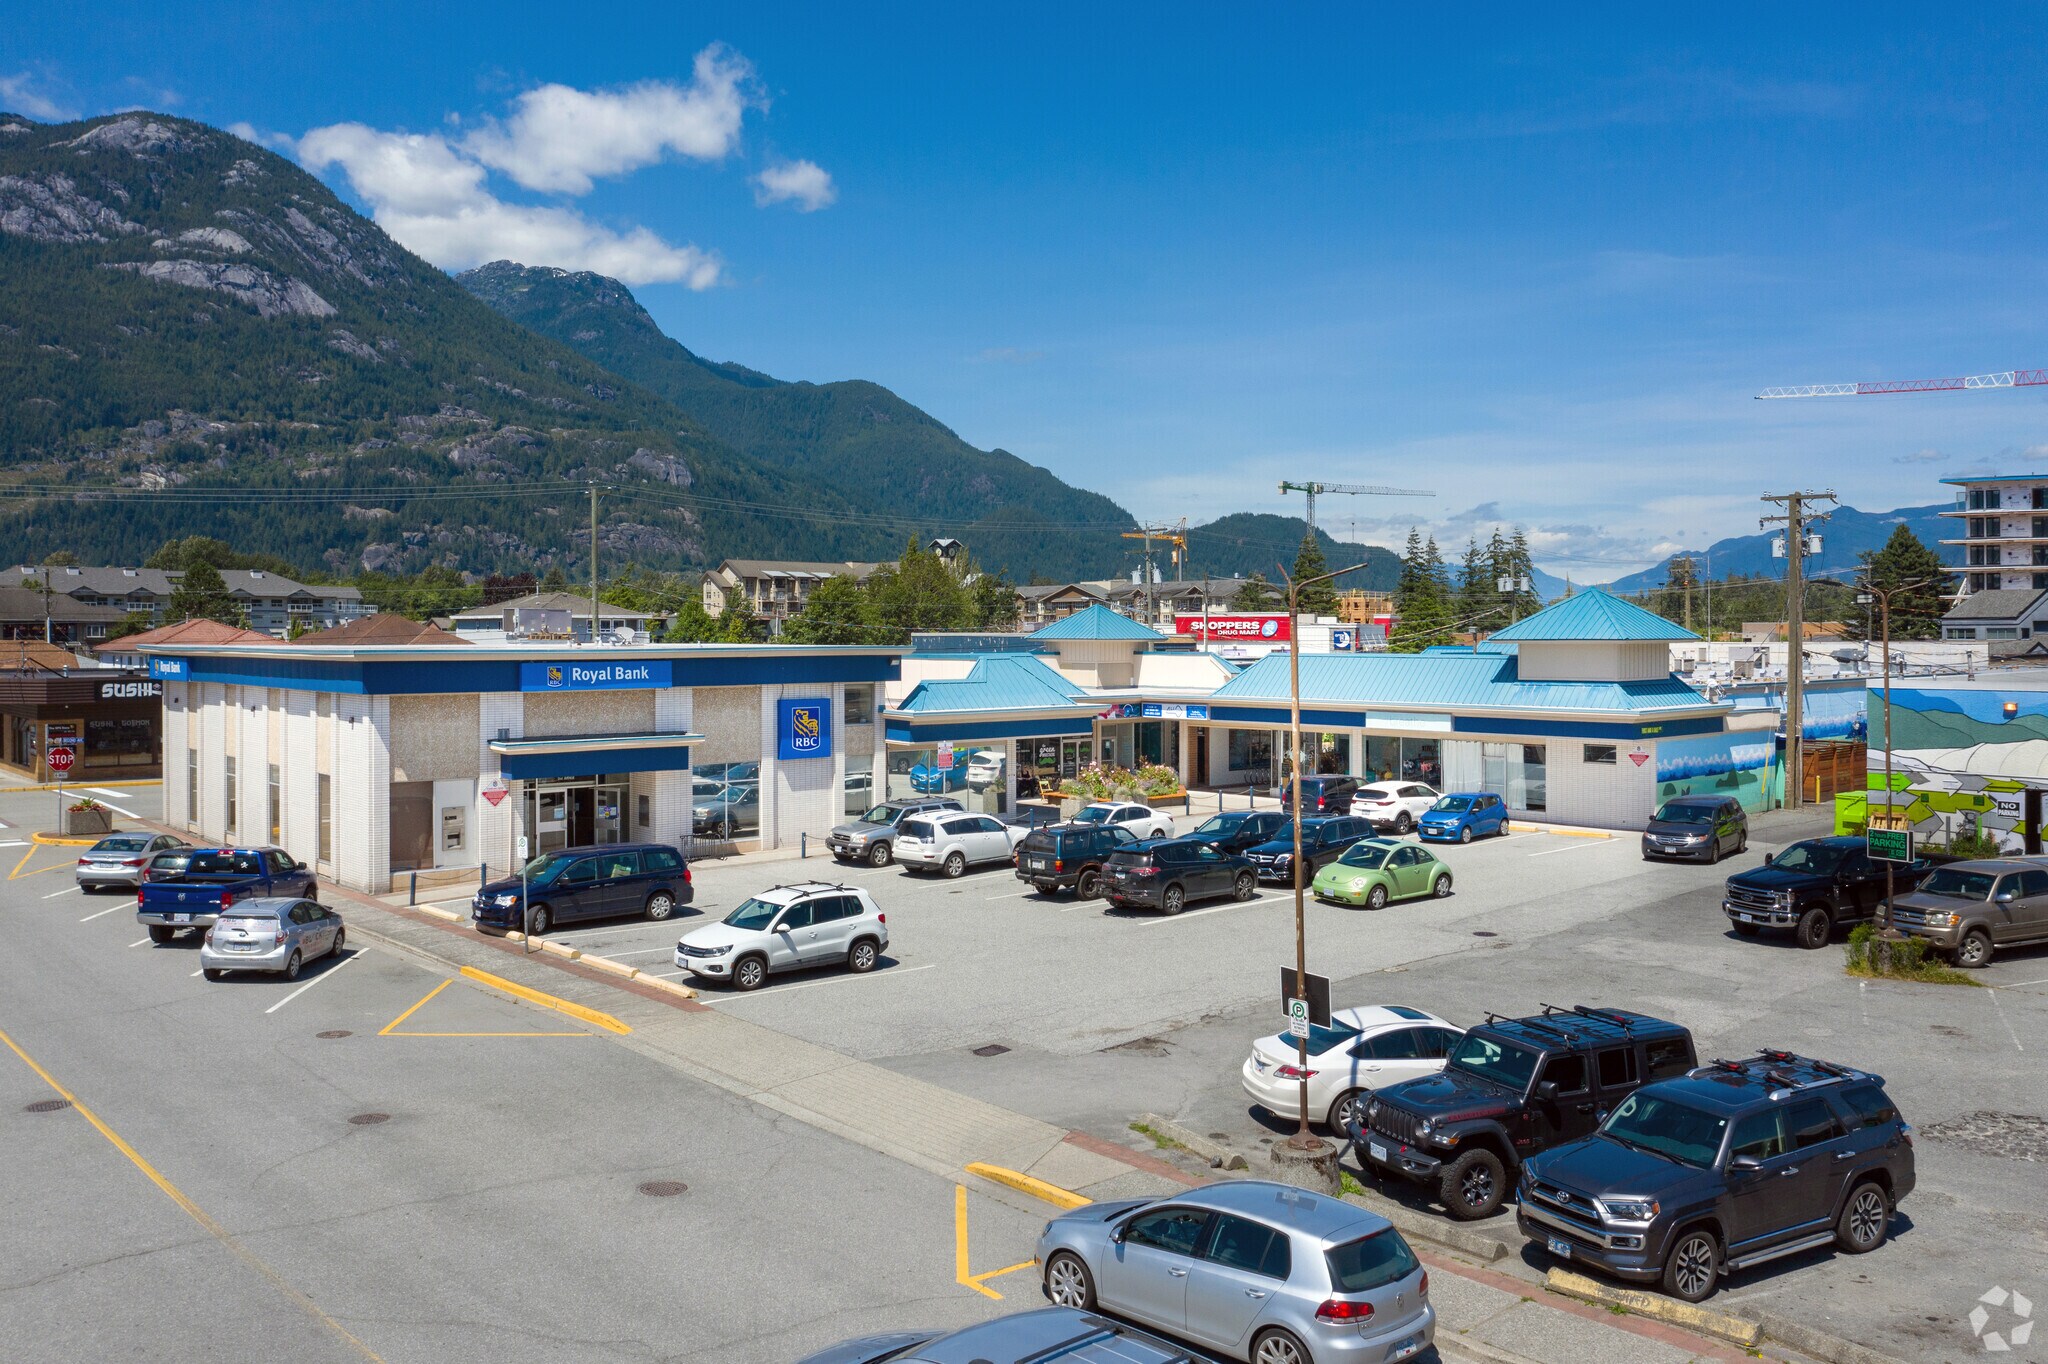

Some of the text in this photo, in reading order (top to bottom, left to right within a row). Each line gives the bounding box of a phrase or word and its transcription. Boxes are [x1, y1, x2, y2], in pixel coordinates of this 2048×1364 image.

[572, 666, 649, 684] Royal Bank
[102, 682, 153, 698] SUSHI
[795, 736, 818, 747] RBC
[49, 754, 74, 765] STOP
[1887, 832, 1906, 840] FREE
[1869, 837, 1906, 849] PARKING
